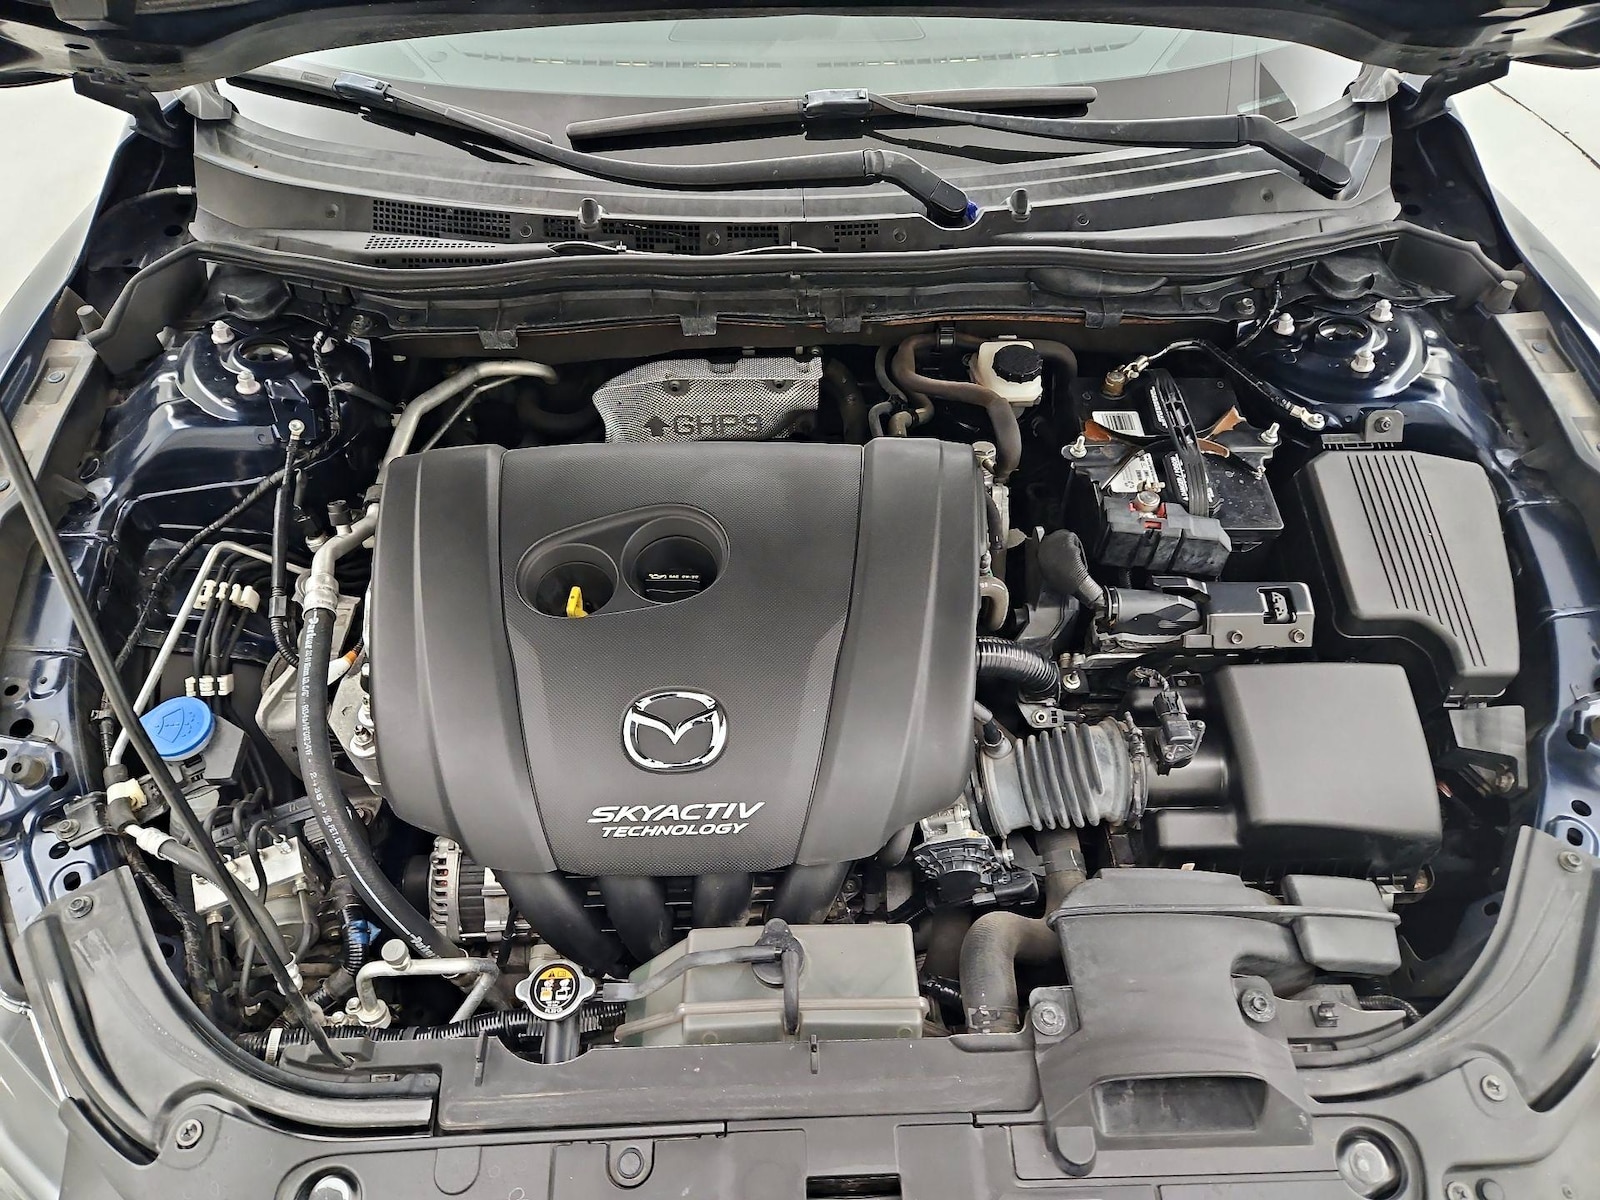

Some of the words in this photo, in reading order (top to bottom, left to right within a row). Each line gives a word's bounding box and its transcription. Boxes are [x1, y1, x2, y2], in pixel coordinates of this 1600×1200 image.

[673, 411, 761, 436] GHP9
[586, 801, 766, 824] SKYACTIV
[601, 822, 750, 839] TECHNOLOGY
